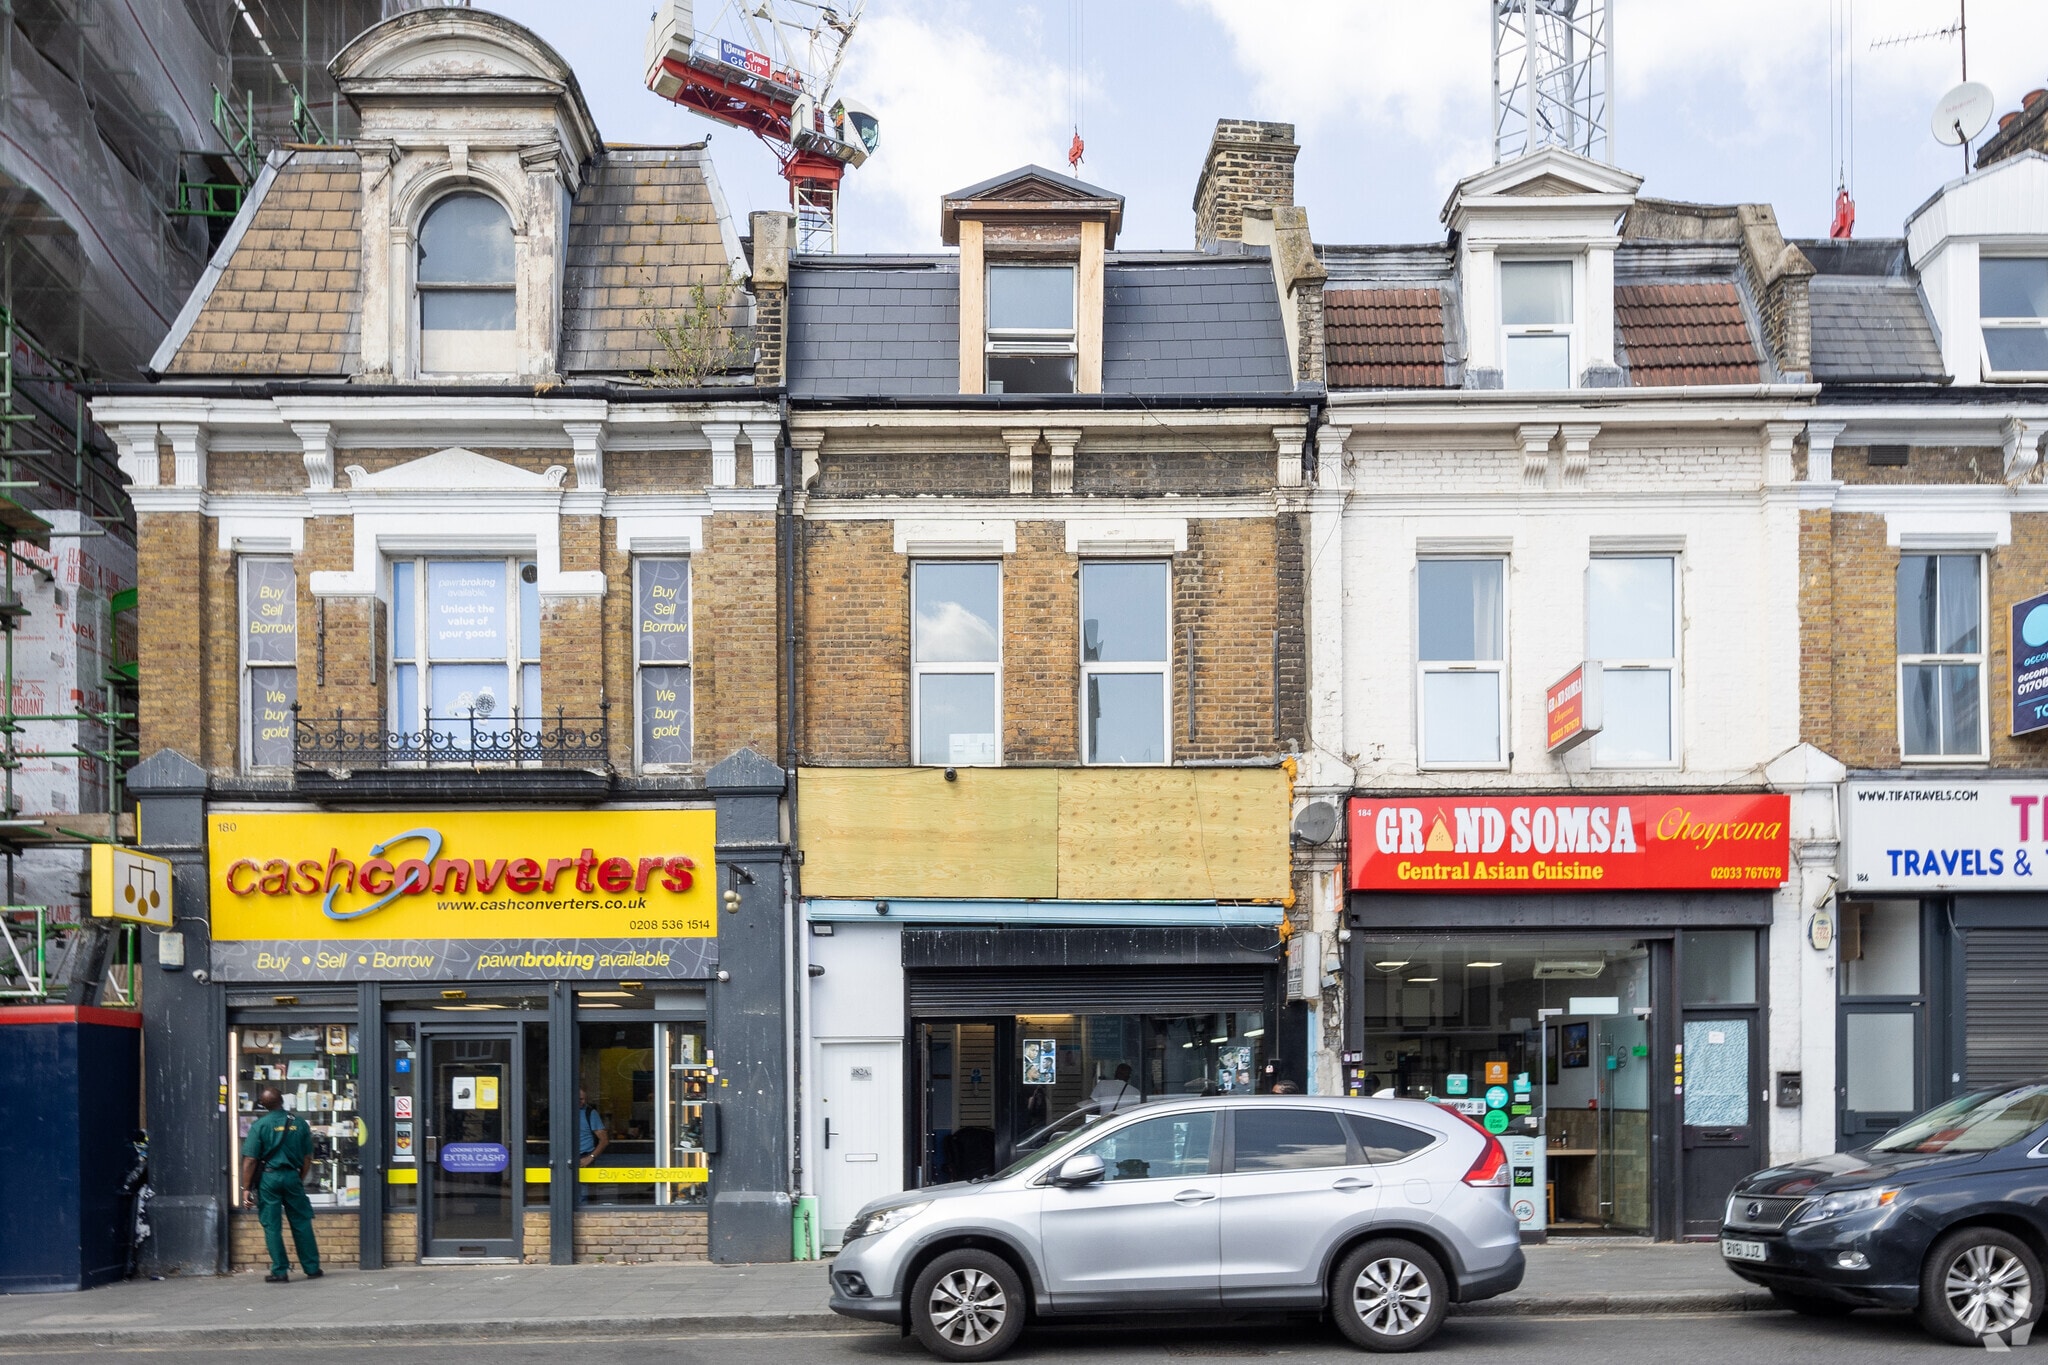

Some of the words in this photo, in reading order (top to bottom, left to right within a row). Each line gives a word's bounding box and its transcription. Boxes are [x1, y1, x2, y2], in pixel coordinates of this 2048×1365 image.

[730, 56, 762, 73] GROUP
[439, 578, 496, 588] pawnbroking
[260, 586, 284, 600] Buy
[652, 585, 677, 599] Buy
[261, 604, 283, 616] Sell
[441, 604, 475, 613] Unlock
[478, 604, 495, 613] the
[653, 604, 676, 615] Sell
[251, 621, 294, 633] Borrow
[447, 617, 475, 626] value
[477, 616, 488, 625] of
[643, 621, 687, 632] Borrow
[439, 630, 463, 640] your
[465, 628, 497, 640] goods
[266, 691, 286, 703] We
[656, 690, 676, 701] We
[264, 708, 287, 722] buy
[655, 708, 677, 722] buy
[262, 726, 289, 740] gold
[653, 725, 680, 739] gold
[1857, 790, 1979, 801] WWW.TIFATRAVELS.COM
[1357, 809, 1371, 817] 184
[217, 822, 237, 832] 180
[1510, 806, 1637, 854] SOMSA
[1657, 807, 1782, 850] Choyxona
[1887, 849, 2004, 876] TRAVELS
[2013, 849, 2033, 876] &
[1397, 861, 1470, 880] Central
[1473, 862, 1529, 880] Asian
[1532, 861, 1603, 880] Cuisine
[1711, 867, 1742, 879] 02033
[1745, 867, 1782, 879] 767678
[1857, 873, 1869, 882] 186
[437, 897, 647, 911] www.cashconverters.co.uk
[629, 919, 658, 930] 0208
[661, 919, 683, 930] 536
[687, 919, 710, 930] 1514
[257, 953, 291, 972] Buy
[316, 953, 347, 968] Sell
[372, 951, 434, 968] Borrow
[478, 951, 594, 971] pawnbroking
[600, 951, 670, 967] available
[475, 1154, 505, 1162] CASH?
[598, 1169, 619, 1180] Buy
[627, 1169, 647, 1179] Sell
[655, 1169, 694, 1179] Borrow
